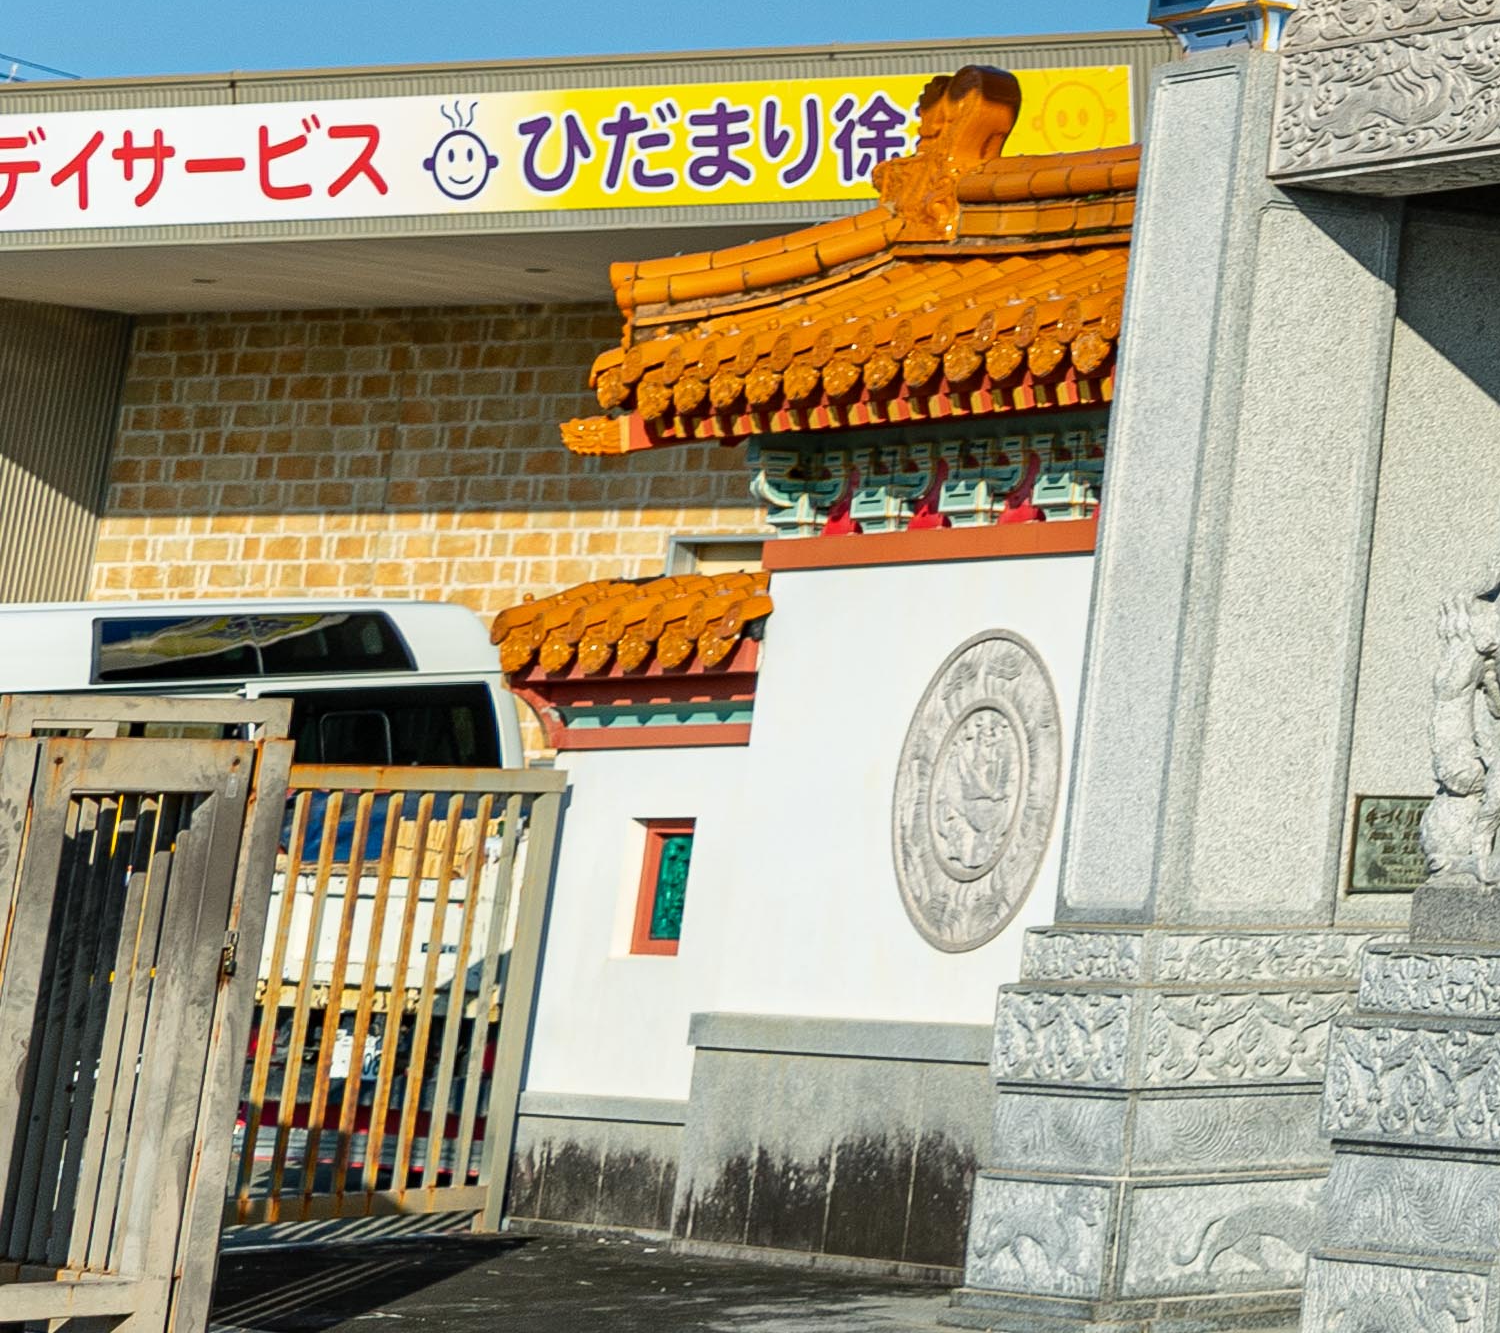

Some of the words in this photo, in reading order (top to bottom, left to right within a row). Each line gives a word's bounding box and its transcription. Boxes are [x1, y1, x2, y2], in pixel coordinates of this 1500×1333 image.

[0, 114, 388, 210] デイサービス
[517, 96, 921, 191] ひだまり徐
